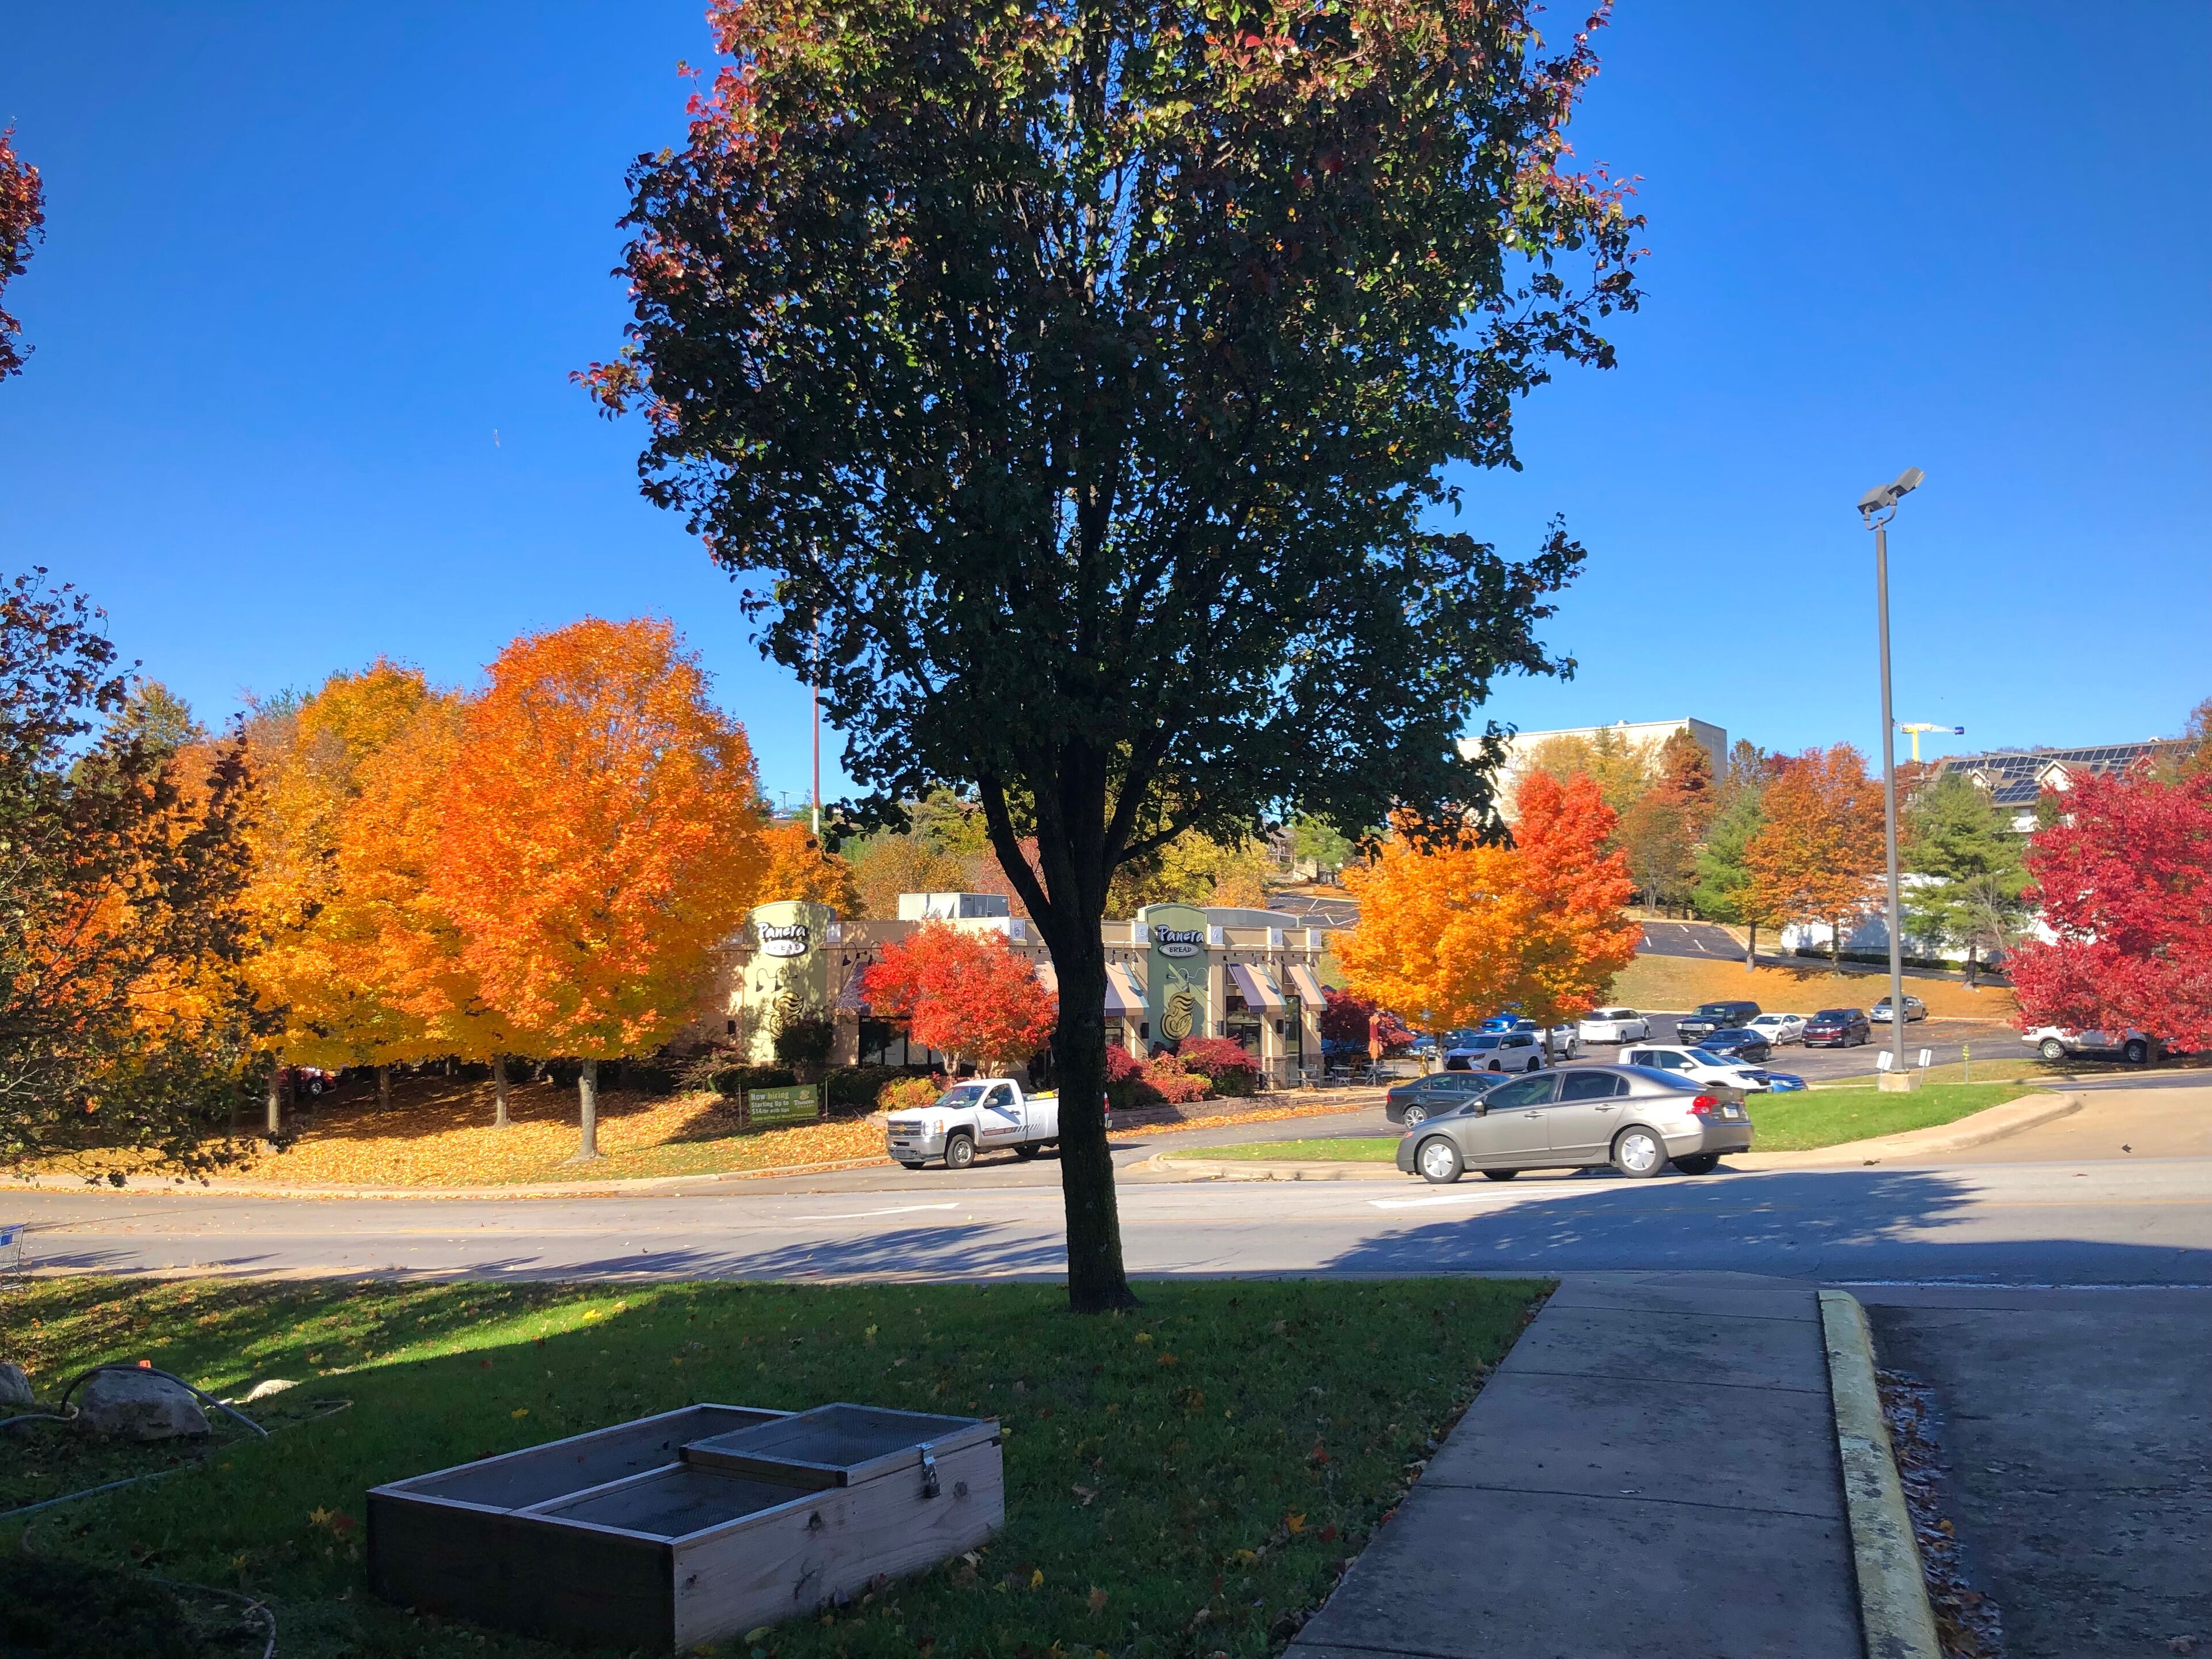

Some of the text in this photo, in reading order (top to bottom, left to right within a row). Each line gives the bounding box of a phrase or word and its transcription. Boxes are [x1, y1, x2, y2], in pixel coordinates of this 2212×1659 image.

[756, 922, 806, 938] Panera
[1157, 925, 1205, 942] Panera
[768, 1091, 790, 1100] hiring
